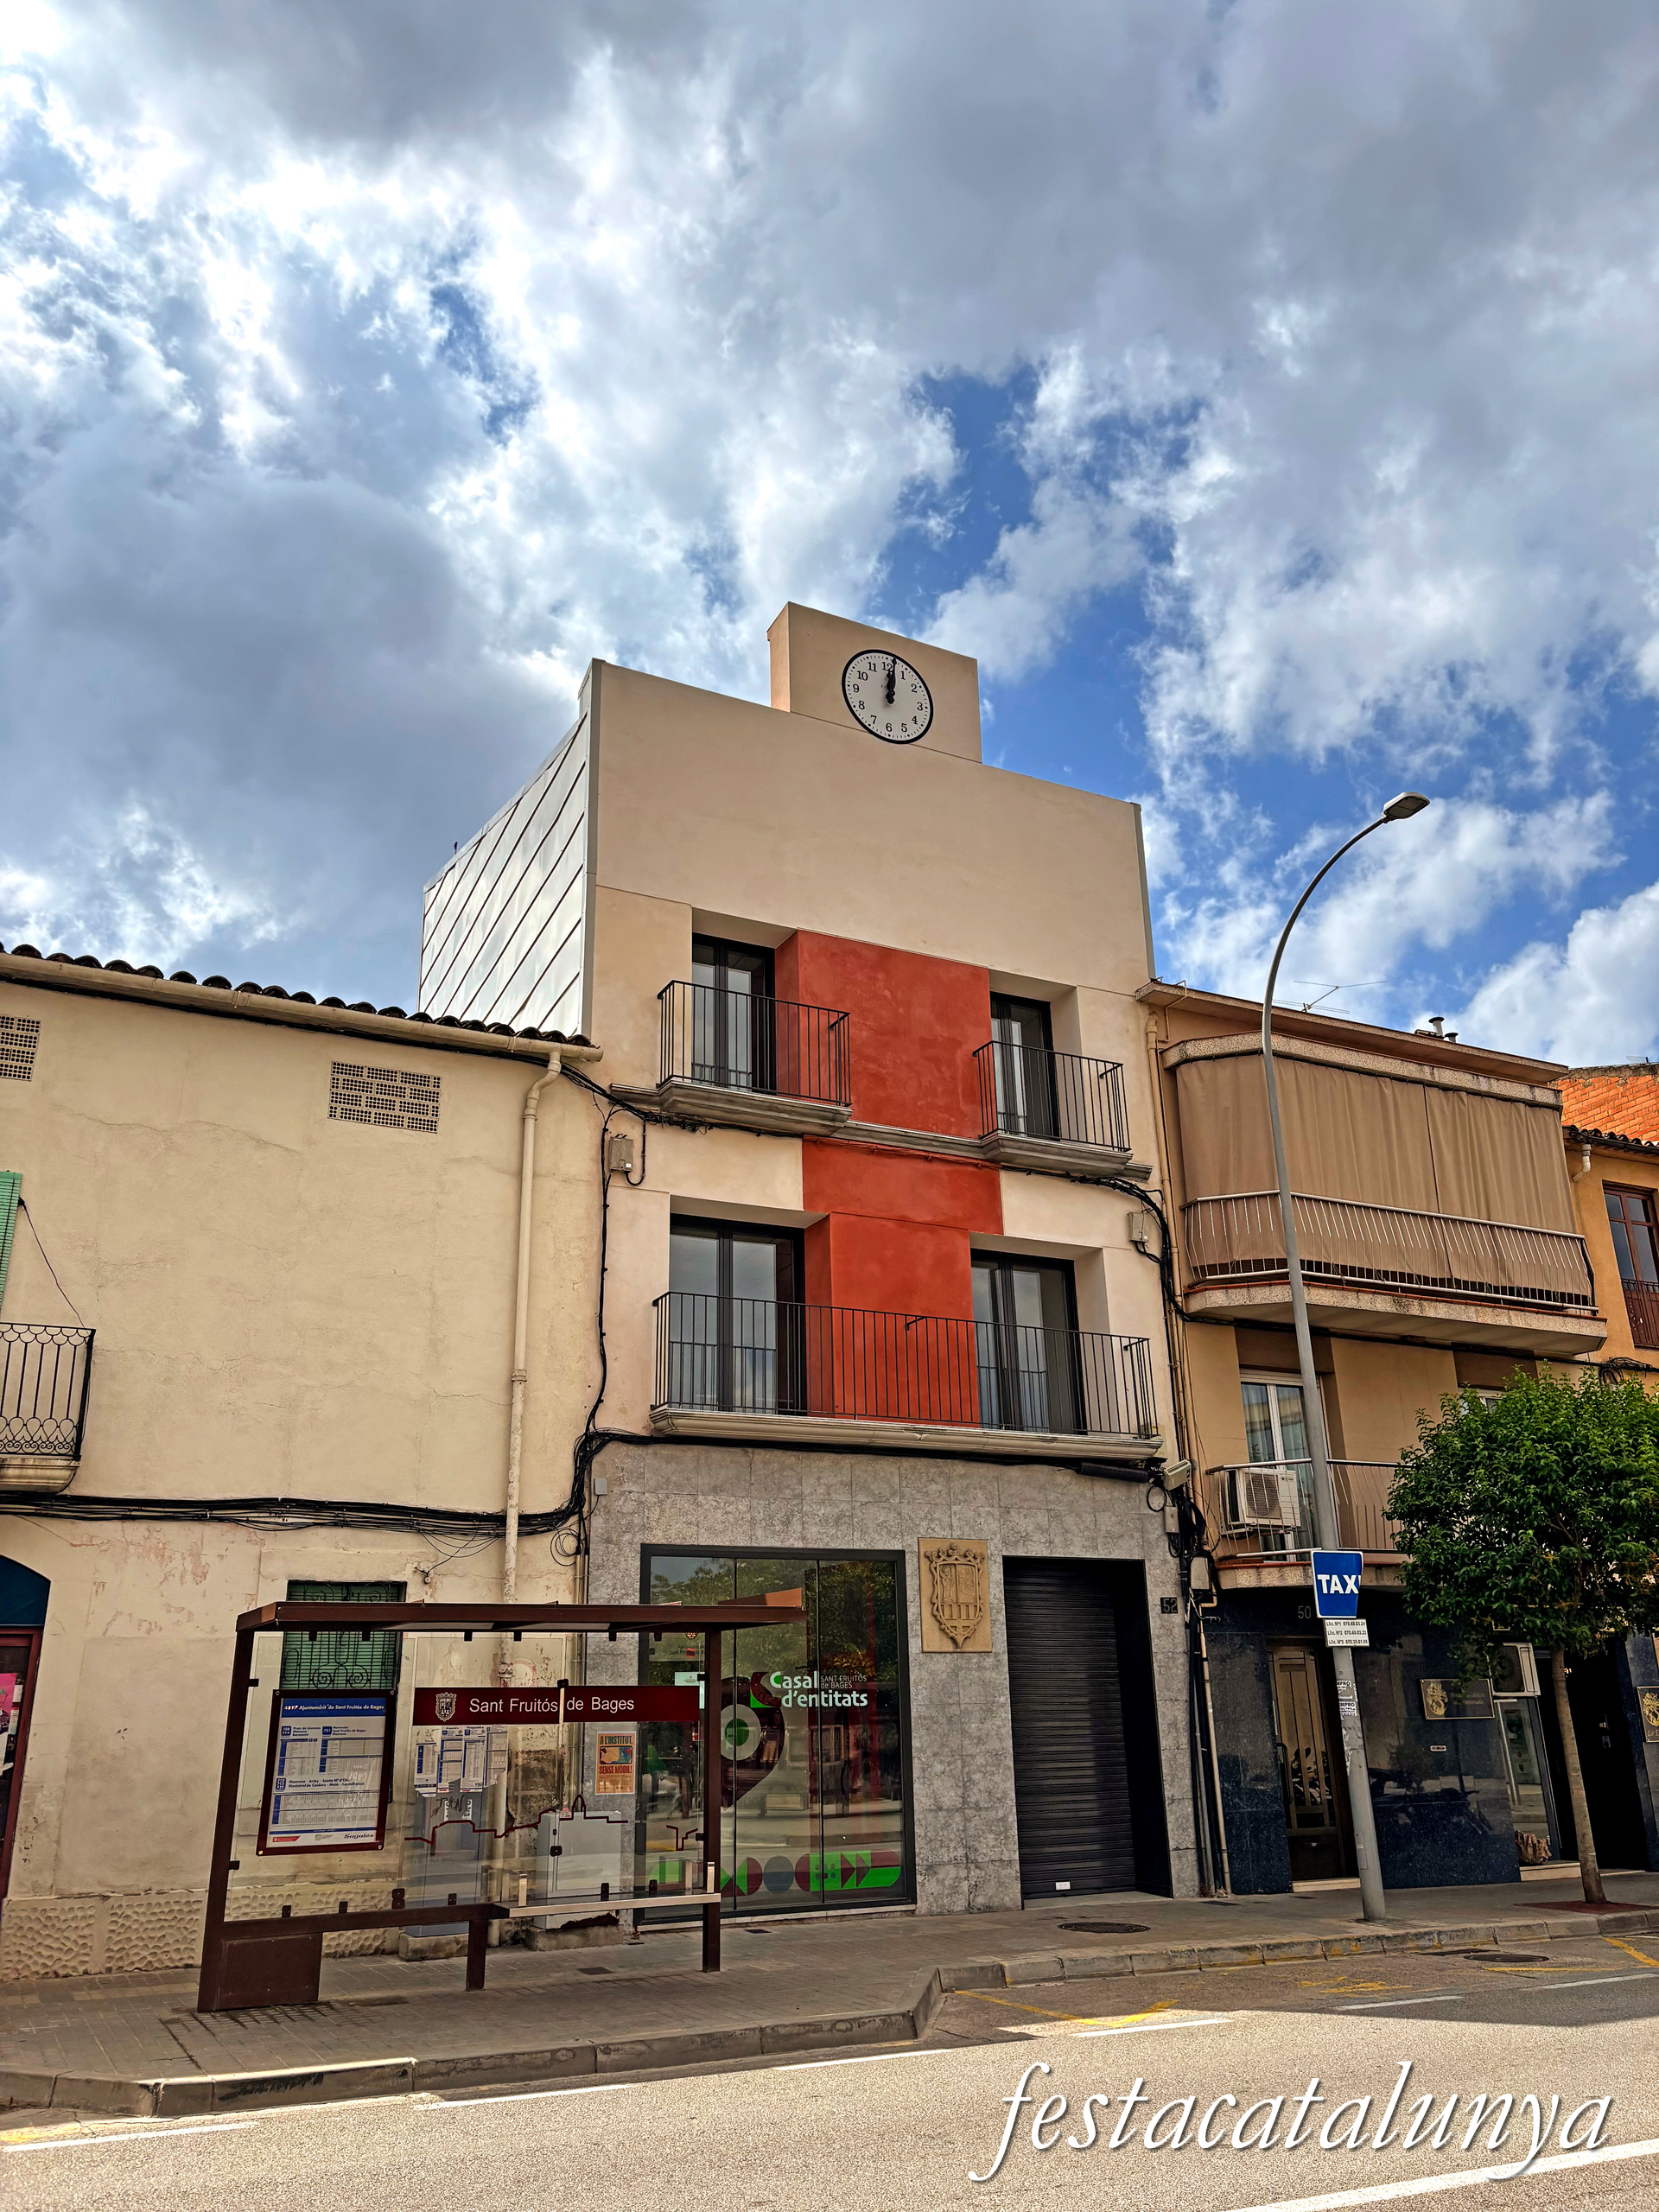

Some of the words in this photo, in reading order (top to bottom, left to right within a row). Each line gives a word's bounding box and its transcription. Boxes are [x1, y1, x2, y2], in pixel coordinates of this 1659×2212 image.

[868, 662, 878, 672] 11
[881, 662, 893, 672] 12
[857, 671, 868, 681] 10
[900, 671, 906, 680] 1
[853, 683, 860, 693] 9
[911, 683, 918, 693] 2
[858, 701, 865, 709] 8
[917, 702, 923, 711] 3
[870, 715, 877, 724] 7
[912, 715, 918, 725] 4
[886, 723, 893, 732] 6
[901, 723, 907, 733] 5
[1317, 1574, 1361, 1594] TAX
[1163, 1599, 1178, 1613] 52
[1298, 1605, 1312, 1619] 50
[770, 1671, 818, 1689] Casal
[781, 1689, 868, 1707] d'entitats
[469, 1698, 504, 1713] Sant
[509, 1697, 558, 1713] Fruitós
[567, 1697, 584, 1710] de
[591, 1696, 635, 1714] Bages
[600, 1736, 604, 1745] A
[599, 1765, 614, 1774] SENSE
